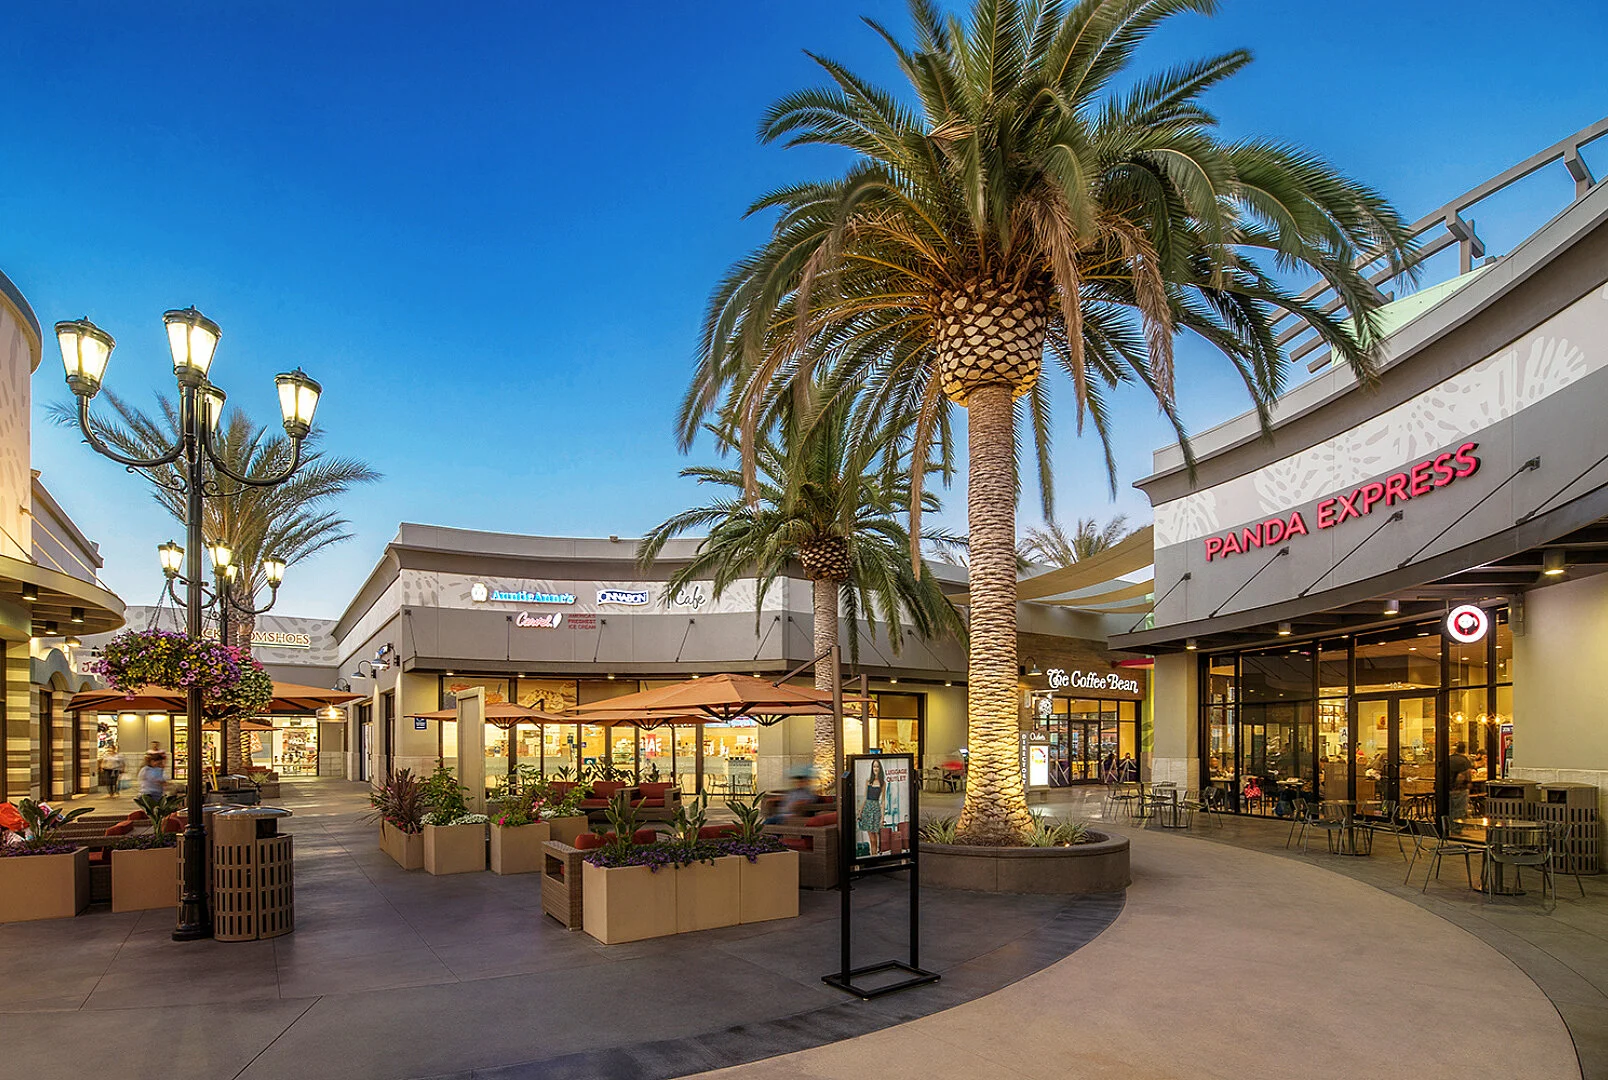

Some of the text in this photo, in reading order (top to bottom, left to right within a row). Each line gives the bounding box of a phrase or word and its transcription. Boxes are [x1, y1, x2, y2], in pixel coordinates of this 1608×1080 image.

[1204, 442, 1481, 562] PANDA EXPRESS
[490, 590, 577, 604] Auntie Anne's
[675, 586, 706, 610] Cafe
[515, 611, 554, 628] Carvel
[1047, 669, 1139, 694] The Coffee Bean
[885, 768, 907, 776] LUGGAGE
